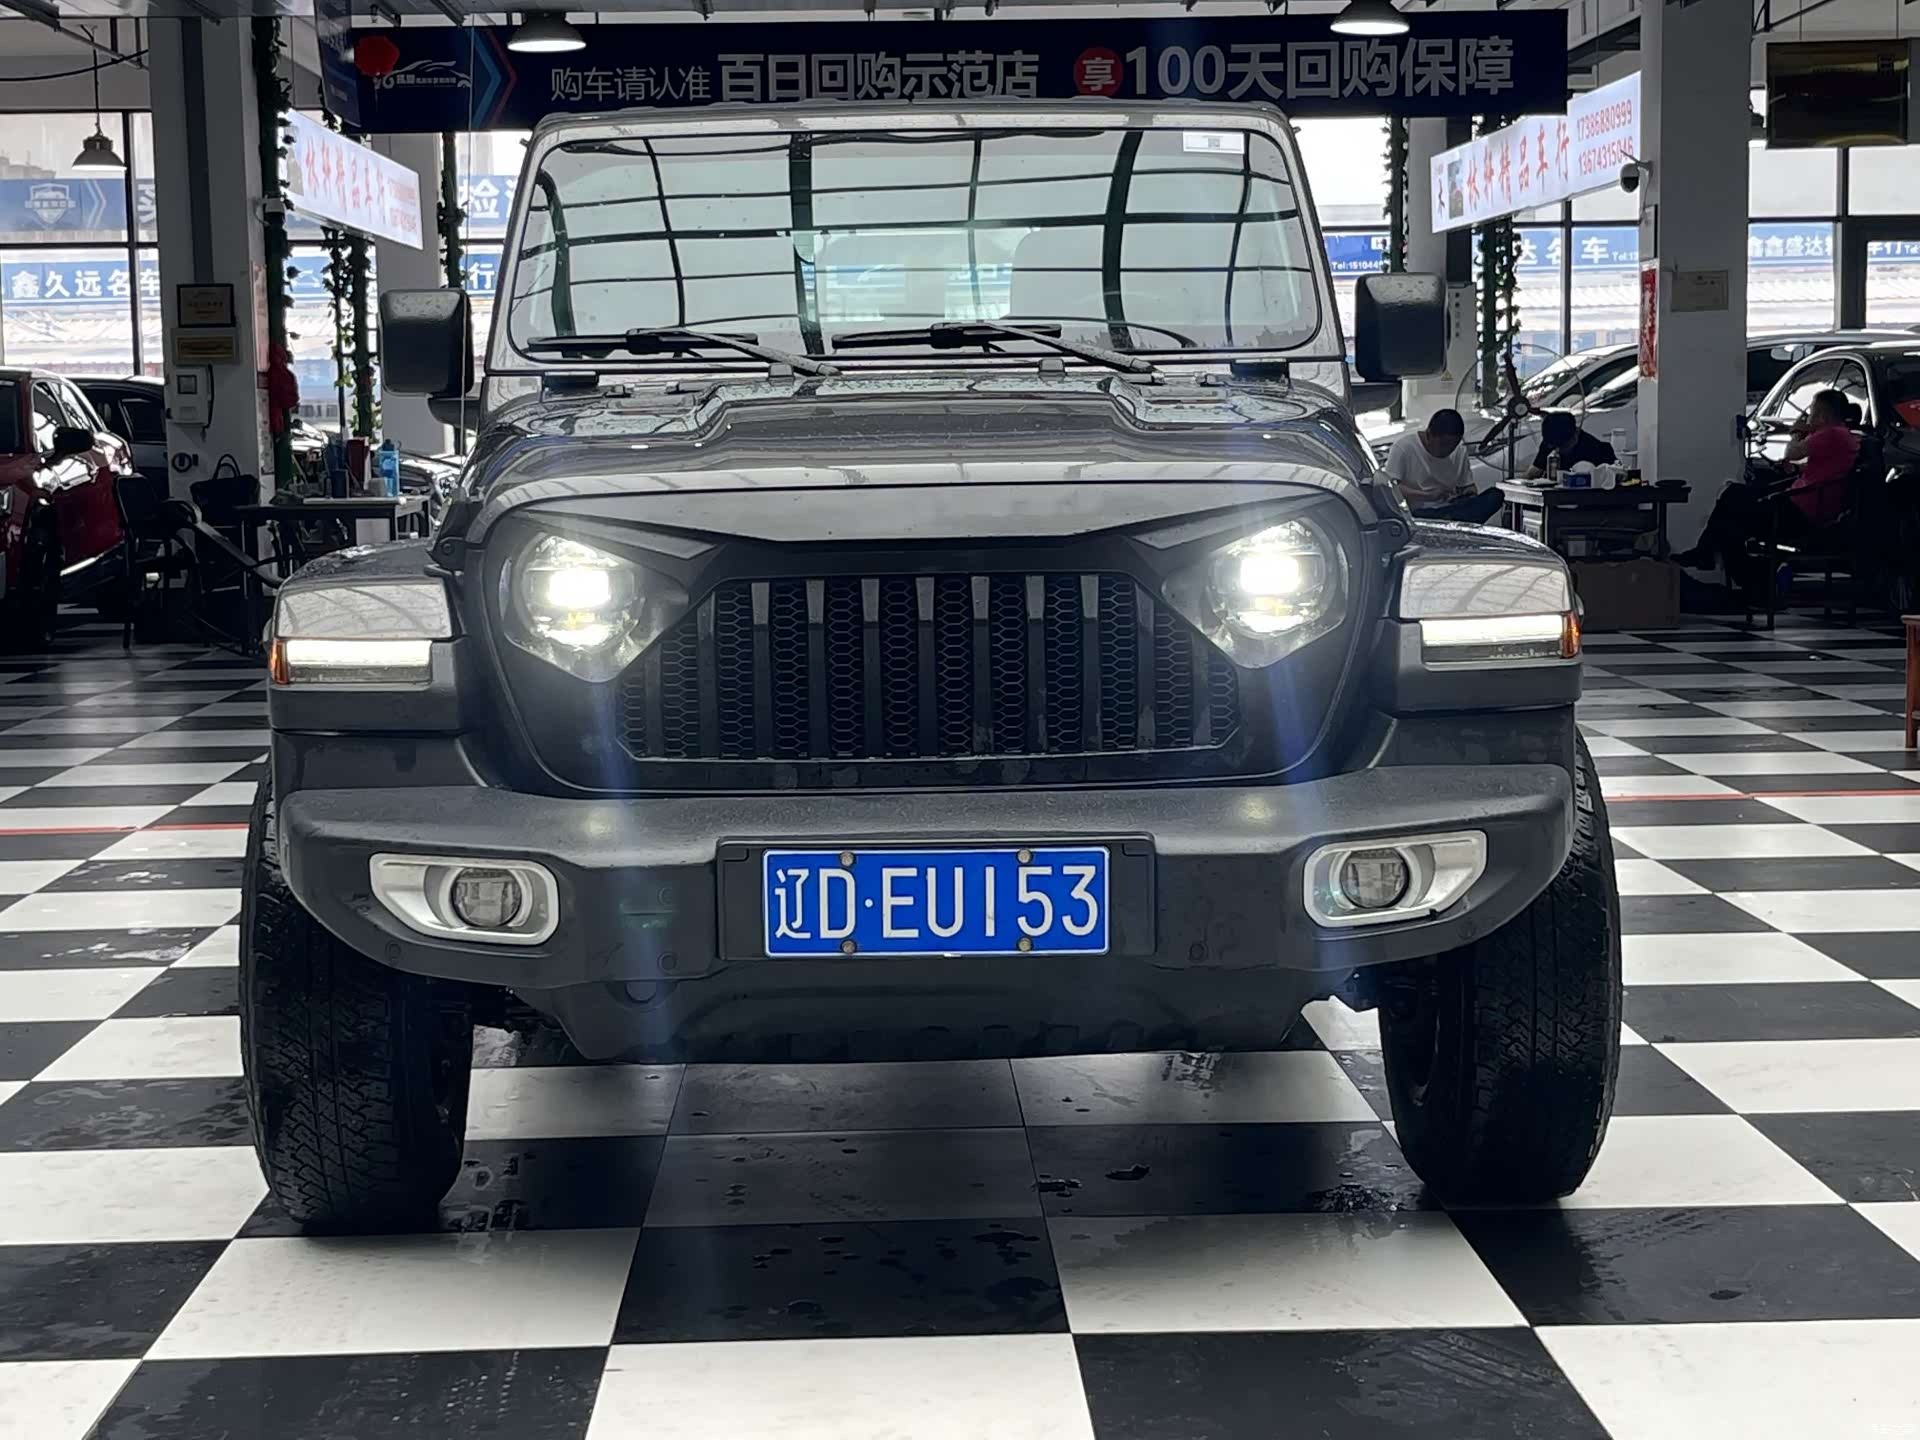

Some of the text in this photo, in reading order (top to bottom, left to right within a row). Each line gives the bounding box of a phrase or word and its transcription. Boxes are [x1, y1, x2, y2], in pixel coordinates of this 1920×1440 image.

[551, 35, 1514, 101] 购车请认准 百日回购示范店 享 100天回购保障
